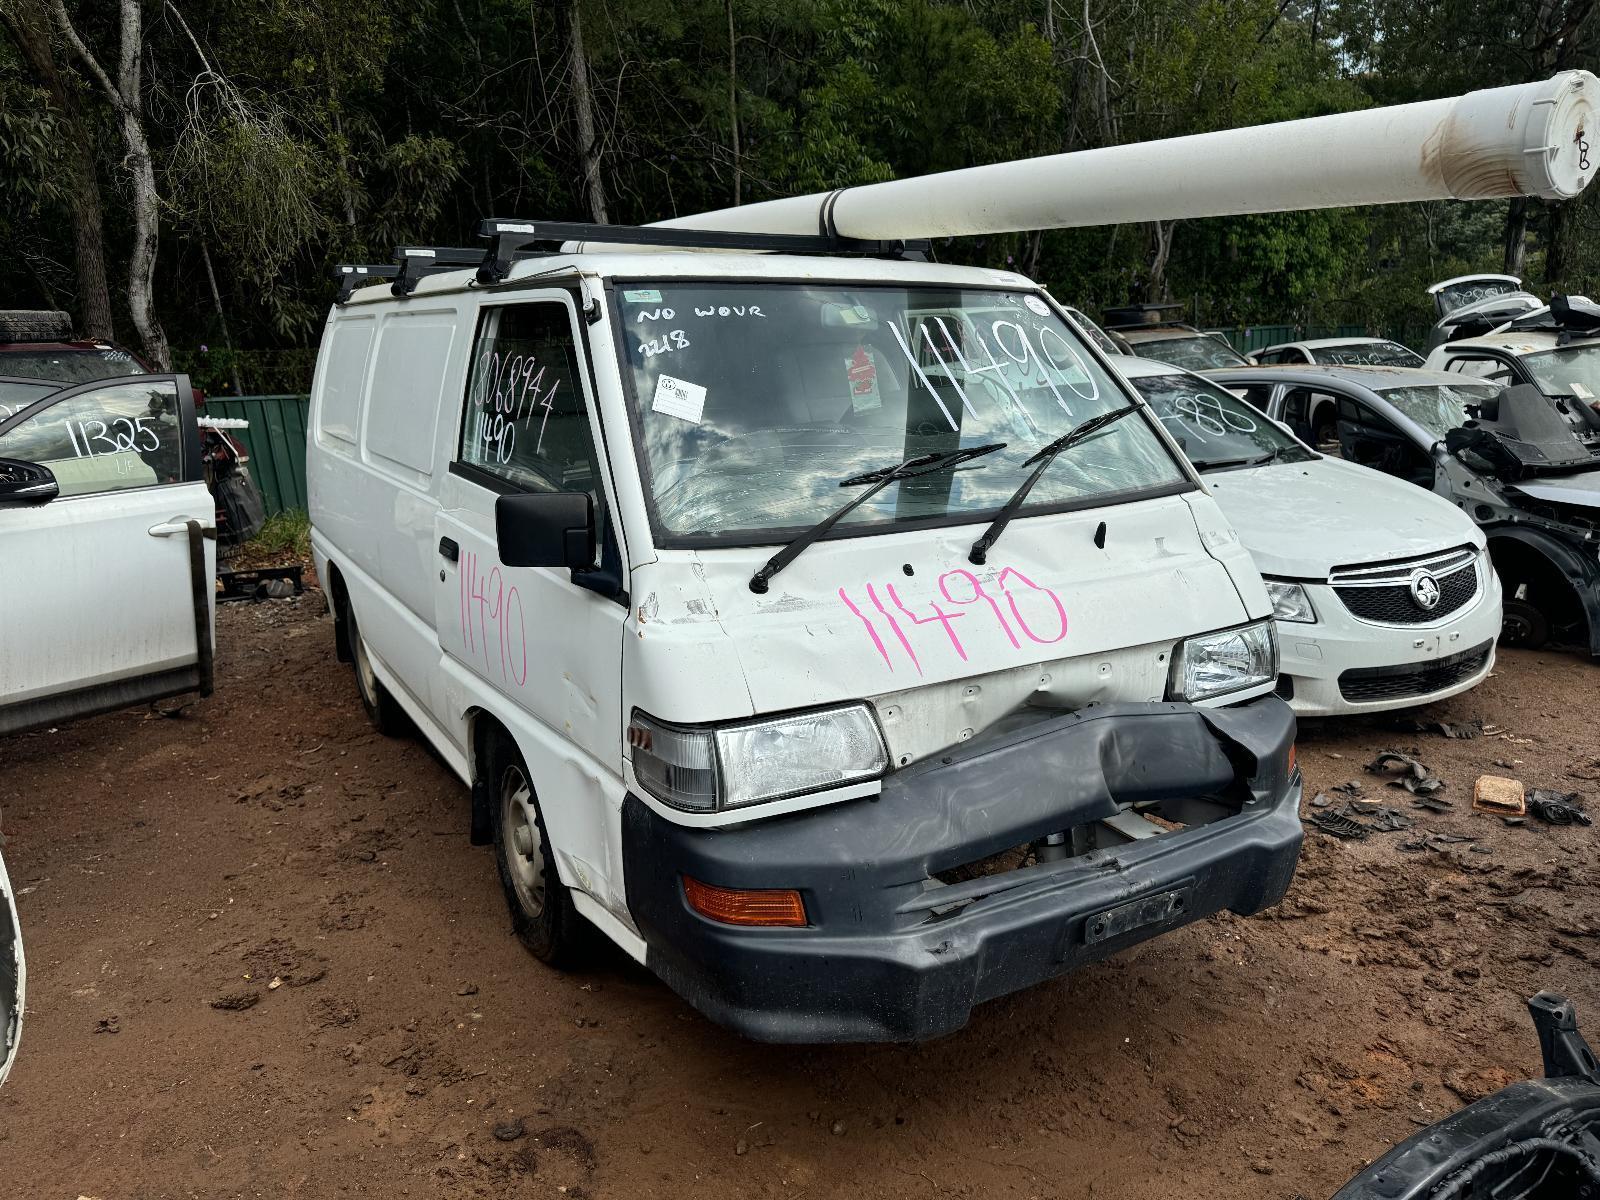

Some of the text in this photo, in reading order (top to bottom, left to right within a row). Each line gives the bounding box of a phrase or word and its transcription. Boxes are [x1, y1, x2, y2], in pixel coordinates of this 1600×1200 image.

[637, 305, 766, 322] NO WOVR
[475, 350, 560, 454] 8068944
[886, 316, 1099, 432] 11490
[66, 416, 160, 459] 11325
[461, 550, 526, 687] 11490
[838, 566, 1068, 677] 11490
